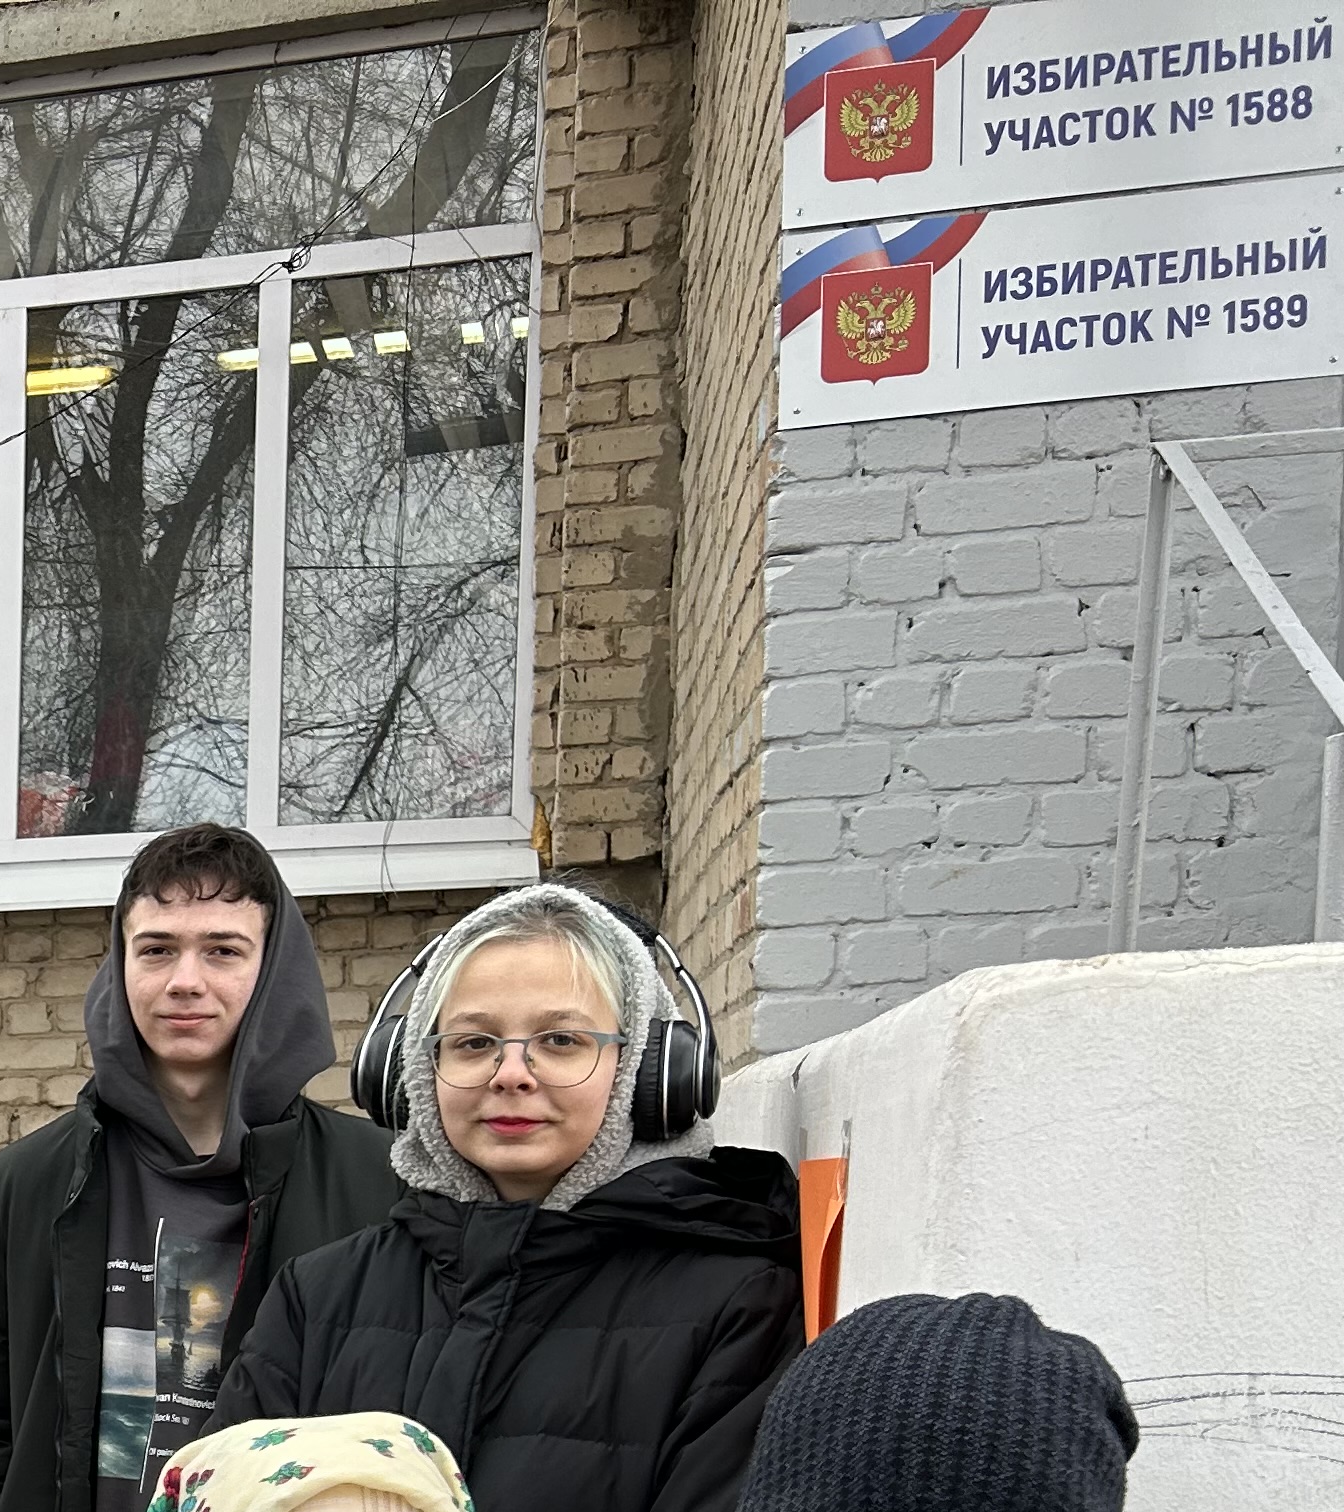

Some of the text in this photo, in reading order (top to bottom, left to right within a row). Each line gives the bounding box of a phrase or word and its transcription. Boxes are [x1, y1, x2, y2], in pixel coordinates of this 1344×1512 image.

[985, 16, 1333, 100] ИЗБИРАТЕЛЬНЫЙ
[984, 84, 1314, 155] УЧАСТОК № 1588
[983, 226, 1328, 303] ИЗБИРАТЕЛЬНЫЙ
[981, 293, 1308, 360] УЧАСТОК № 1589
